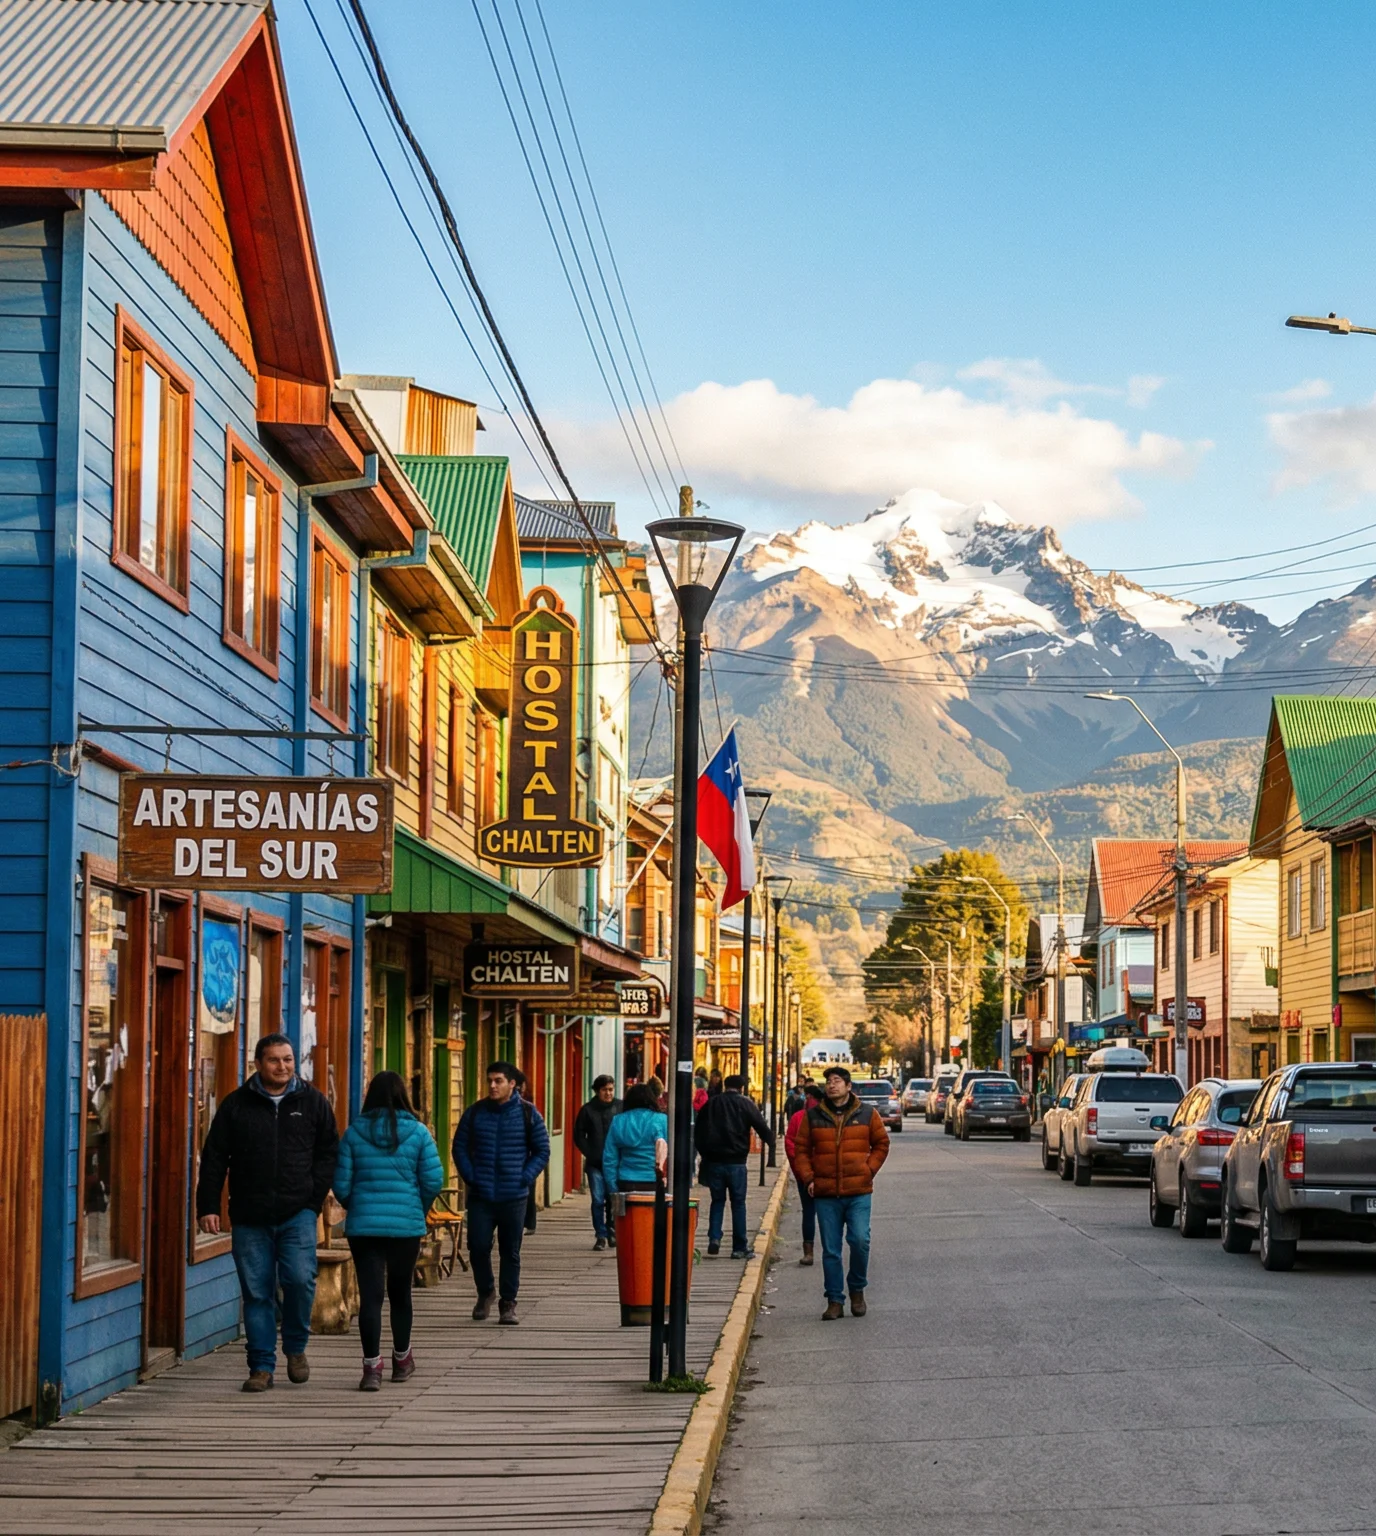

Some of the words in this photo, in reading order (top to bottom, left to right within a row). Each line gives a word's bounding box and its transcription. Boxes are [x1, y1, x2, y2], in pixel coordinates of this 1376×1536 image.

[523, 630, 562, 821] HOSTAL
[132, 781, 379, 833] ARTESANÍAS
[174, 838, 247, 878] DEL
[259, 839, 339, 880] SUR
[485, 829, 596, 855] CHALTEN
[488, 950, 553, 964] HOSTAL
[470, 966, 569, 983] CHALTEN
